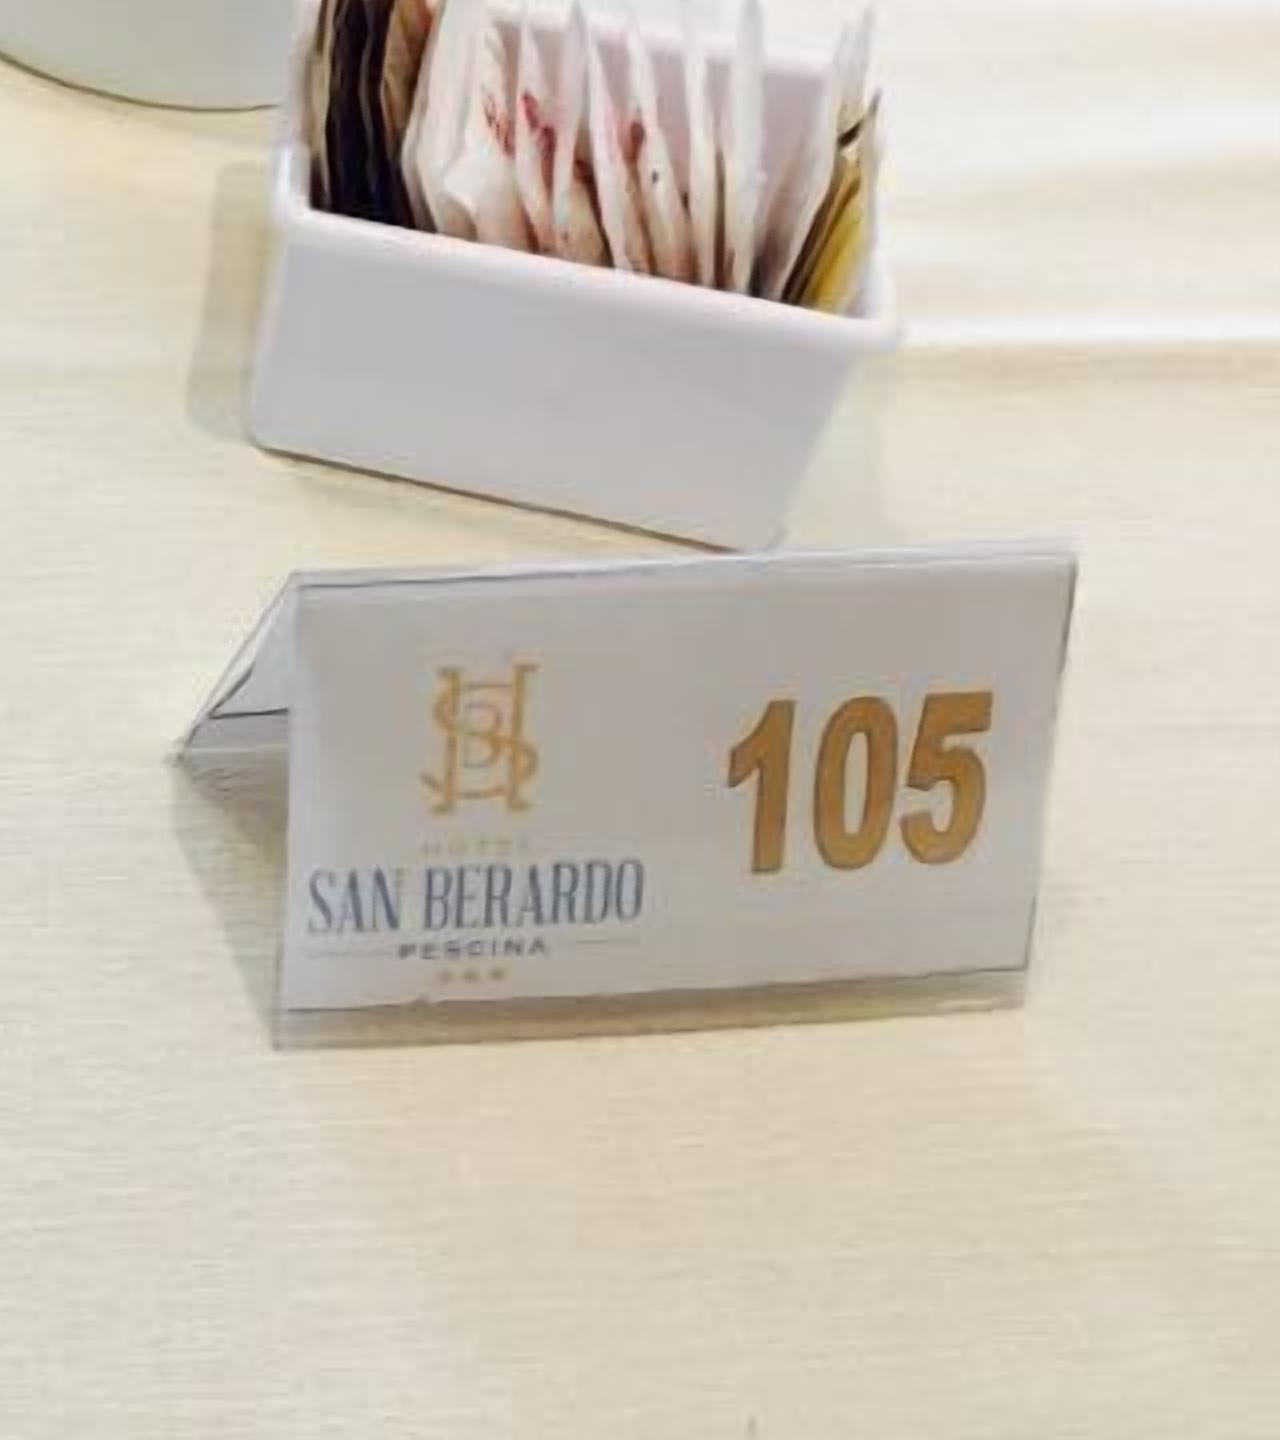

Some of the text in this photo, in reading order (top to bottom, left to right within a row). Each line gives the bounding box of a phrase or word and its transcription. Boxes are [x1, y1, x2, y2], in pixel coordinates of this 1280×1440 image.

[728, 691, 992, 875] 105
[307, 857, 644, 935] SAN BERARDO
[397, 937, 548, 960] PESCINA
